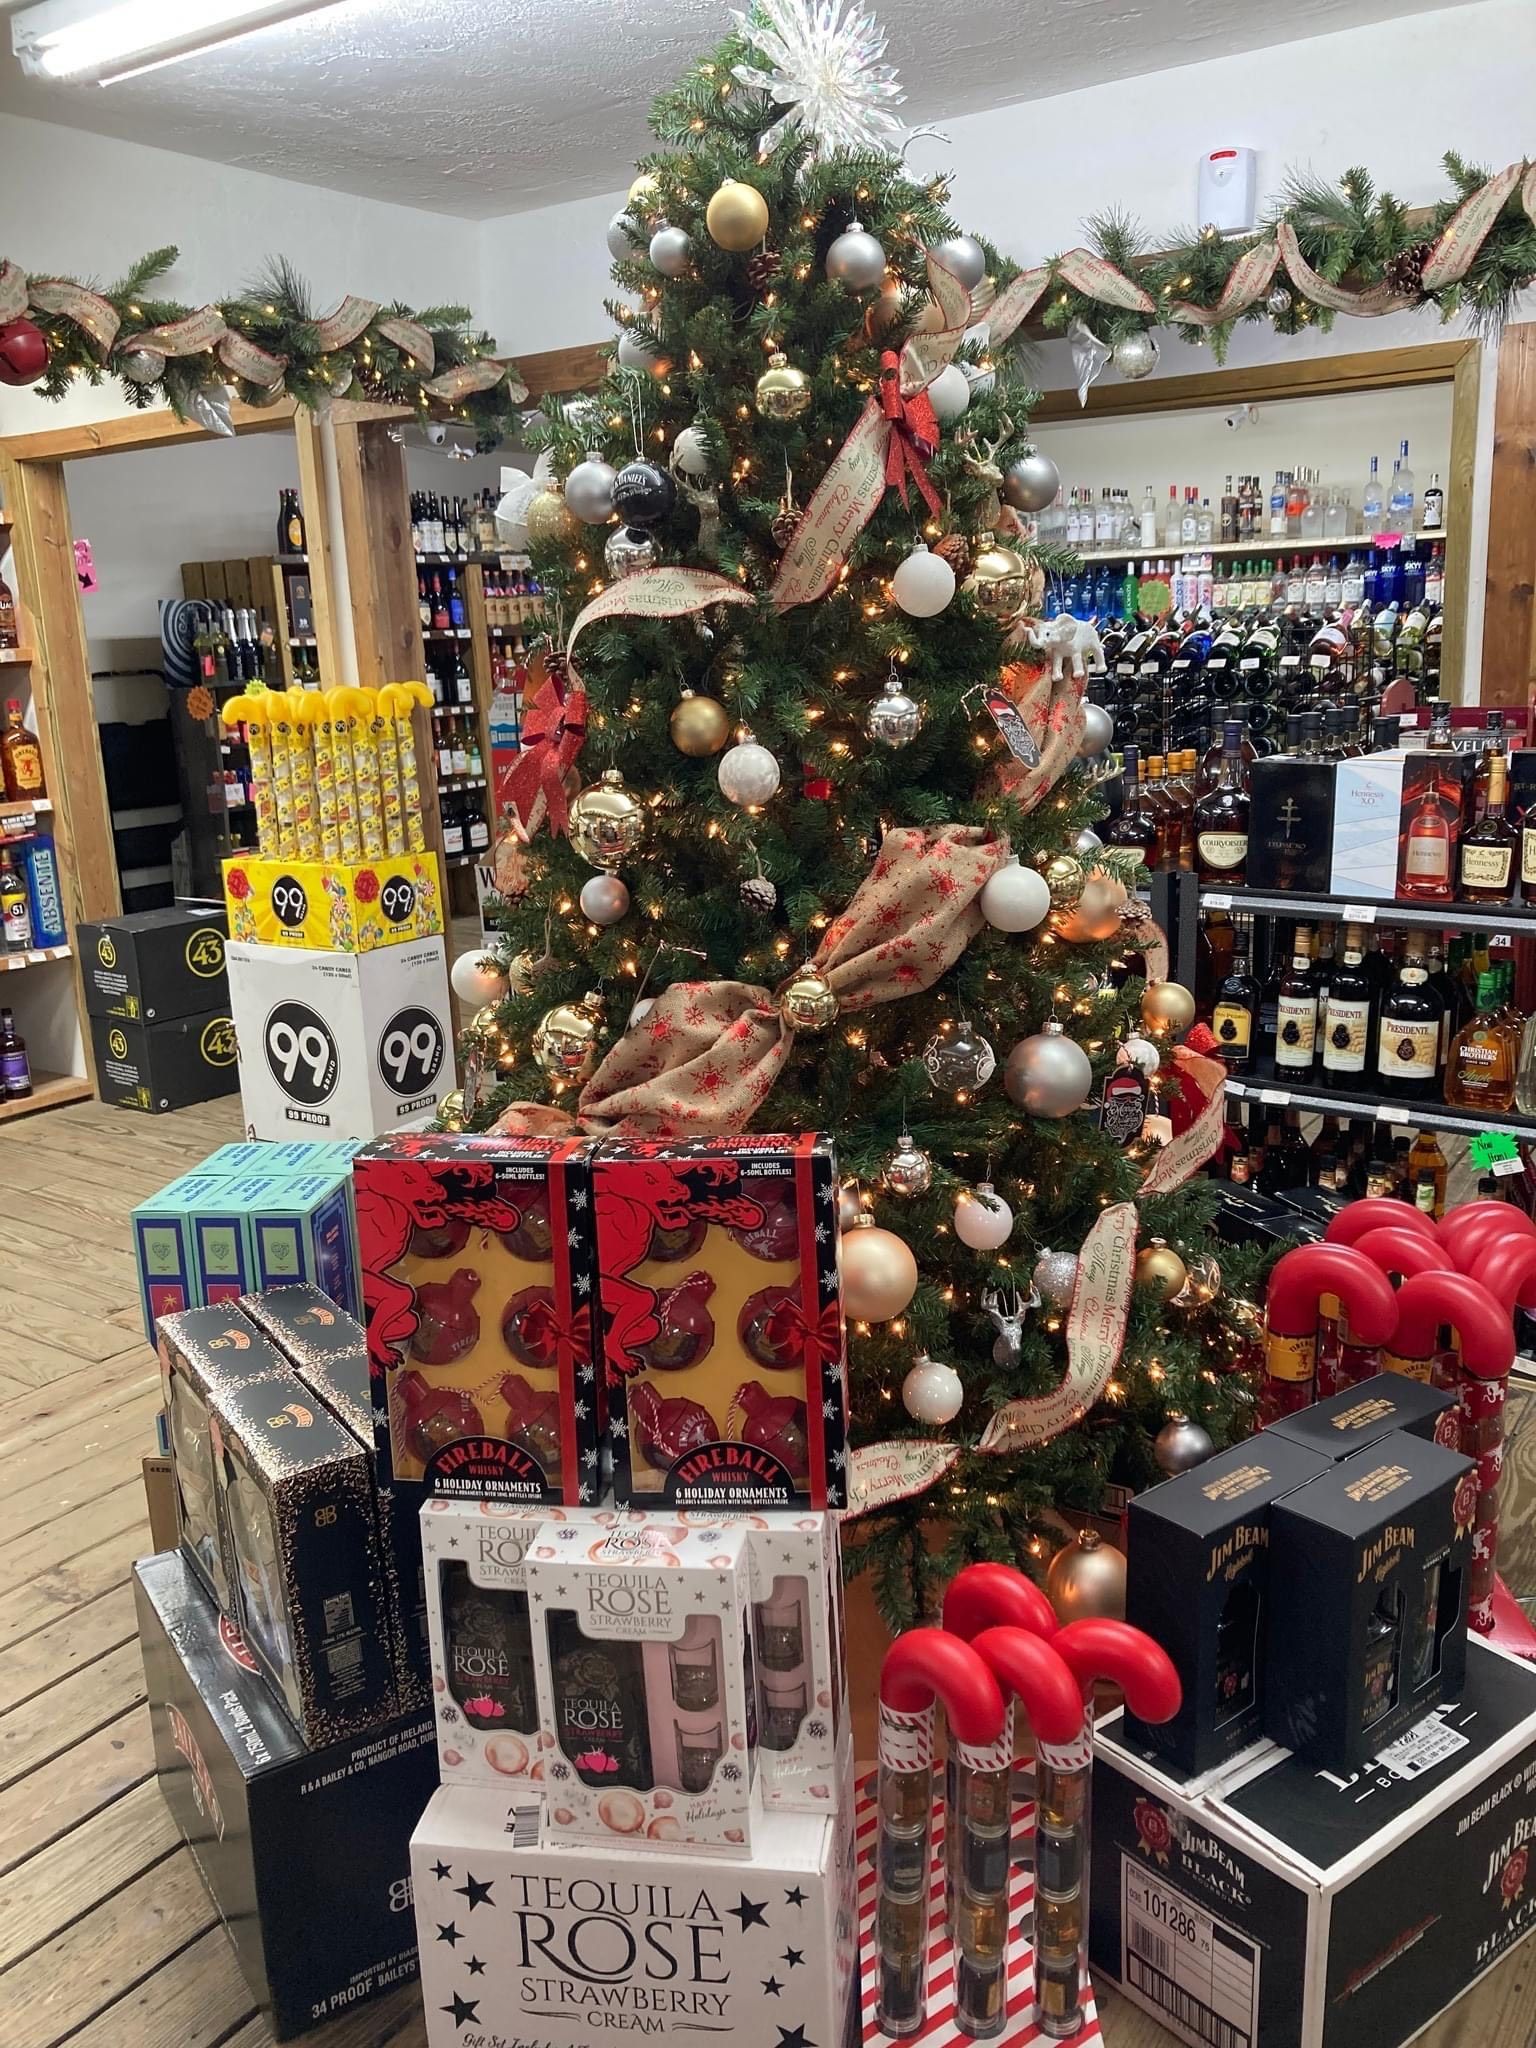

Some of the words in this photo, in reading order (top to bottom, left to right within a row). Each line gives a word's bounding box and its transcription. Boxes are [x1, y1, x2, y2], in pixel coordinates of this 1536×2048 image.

[833, 499, 865, 539] Merry
[807, 537, 839, 594] Christmas
[1404, 562, 1422, 570] SKYY
[1466, 856, 1499, 867] Hennessy
[35, 851, 59, 935] ABSENTE
[273, 886, 303, 920] 99
[383, 884, 411, 916] 99
[101, 946, 113, 961] 43
[192, 938, 223, 966] 43
[1494, 935, 1508, 947] 34
[1386, 1021, 1429, 1035] PRESIDENTE
[112, 1035, 124, 1052] 43
[269, 1021, 330, 1088] 99
[383, 1023, 436, 1083] 99
[1459, 1045, 1498, 1056] CHRISTIAN
[1459, 1052, 1497, 1061] BROTHERS
[430, 1044, 442, 1074] BRAND
[323, 1060, 336, 1091] BRAND
[288, 1110, 300, 1120] 99
[301, 1111, 328, 1126] PROOF
[399, 1105, 410, 1114] 99
[411, 1096, 435, 1111] PROOF
[707, 1139, 800, 1149] ORNAMENTS
[1477, 1140, 1493, 1150] New
[1105, 1235, 1125, 1303] Christmas
[1098, 1303, 1117, 1345] Merry
[436, 1442, 533, 1479] FIREBALL
[468, 1464, 504, 1476] WHISKY
[678, 1447, 779, 1484] FIREBALL
[435, 1478, 440, 1488] 6
[443, 1478, 483, 1490] HOLIDAY
[485, 1481, 541, 1493] ORNAMENTS
[712, 1472, 749, 1483] WHISKY
[869, 1474, 908, 1492] Merry
[676, 1487, 681, 1498] 6
[685, 1487, 726, 1498] HOLIDAY
[729, 1487, 787, 1498] ORNAMENTS
[1206, 1538, 1233, 1583] JIM
[1235, 1525, 1270, 1549] BEAM
[1357, 1538, 1383, 1584] JIM
[1384, 1525, 1415, 1550] BEAM
[585, 1573, 667, 1590] TEQUILA
[587, 1588, 673, 1616] ROSE
[589, 1614, 673, 1628] STRAWBERRY
[615, 1627, 648, 1636] CREAM
[452, 1645, 508, 1663] TEQUILA
[454, 1655, 510, 1677] ROSE
[218, 1688, 240, 1710] Pack
[563, 1698, 620, 1712] TEQUILA
[227, 1703, 250, 1728] Bowls
[564, 1708, 624, 1730] ROSE
[351, 1739, 387, 1761] PRODUCT
[389, 1734, 399, 1746] OF
[301, 1785, 307, 1795] R
[308, 1781, 314, 1792] &
[315, 1779, 321, 1789] A
[321, 1767, 346, 1787] BAILEY
[347, 1765, 353, 1775] &
[354, 1761, 366, 1773] CO,
[368, 1748, 397, 1767] NANGOR
[398, 1739, 419, 1753] ROAD,
[685, 1807, 727, 1823] Holidays
[1456, 1815, 1470, 1837] JIM
[1470, 1798, 1491, 1825] BEAM
[1491, 1780, 1513, 1809] BLACK
[1182, 1830, 1208, 1854] JIM
[1209, 1839, 1245, 1889] BEAM
[1482, 1836, 1512, 1895] JIM
[510, 1873, 721, 1922] TEQUILA
[1144, 1889, 1196, 1943] 101286
[512, 1910, 731, 1985] ROSE
[350, 1961, 385, 1985] IMPORTED
[387, 1955, 397, 1966] BY
[312, 2000, 327, 2019] 34
[330, 1978, 374, 2010] PROOF
[378, 1959, 416, 1987] BAILEYS
[519, 1977, 731, 2017] STRAWBERRY
[587, 2010, 666, 2036] CREAM
